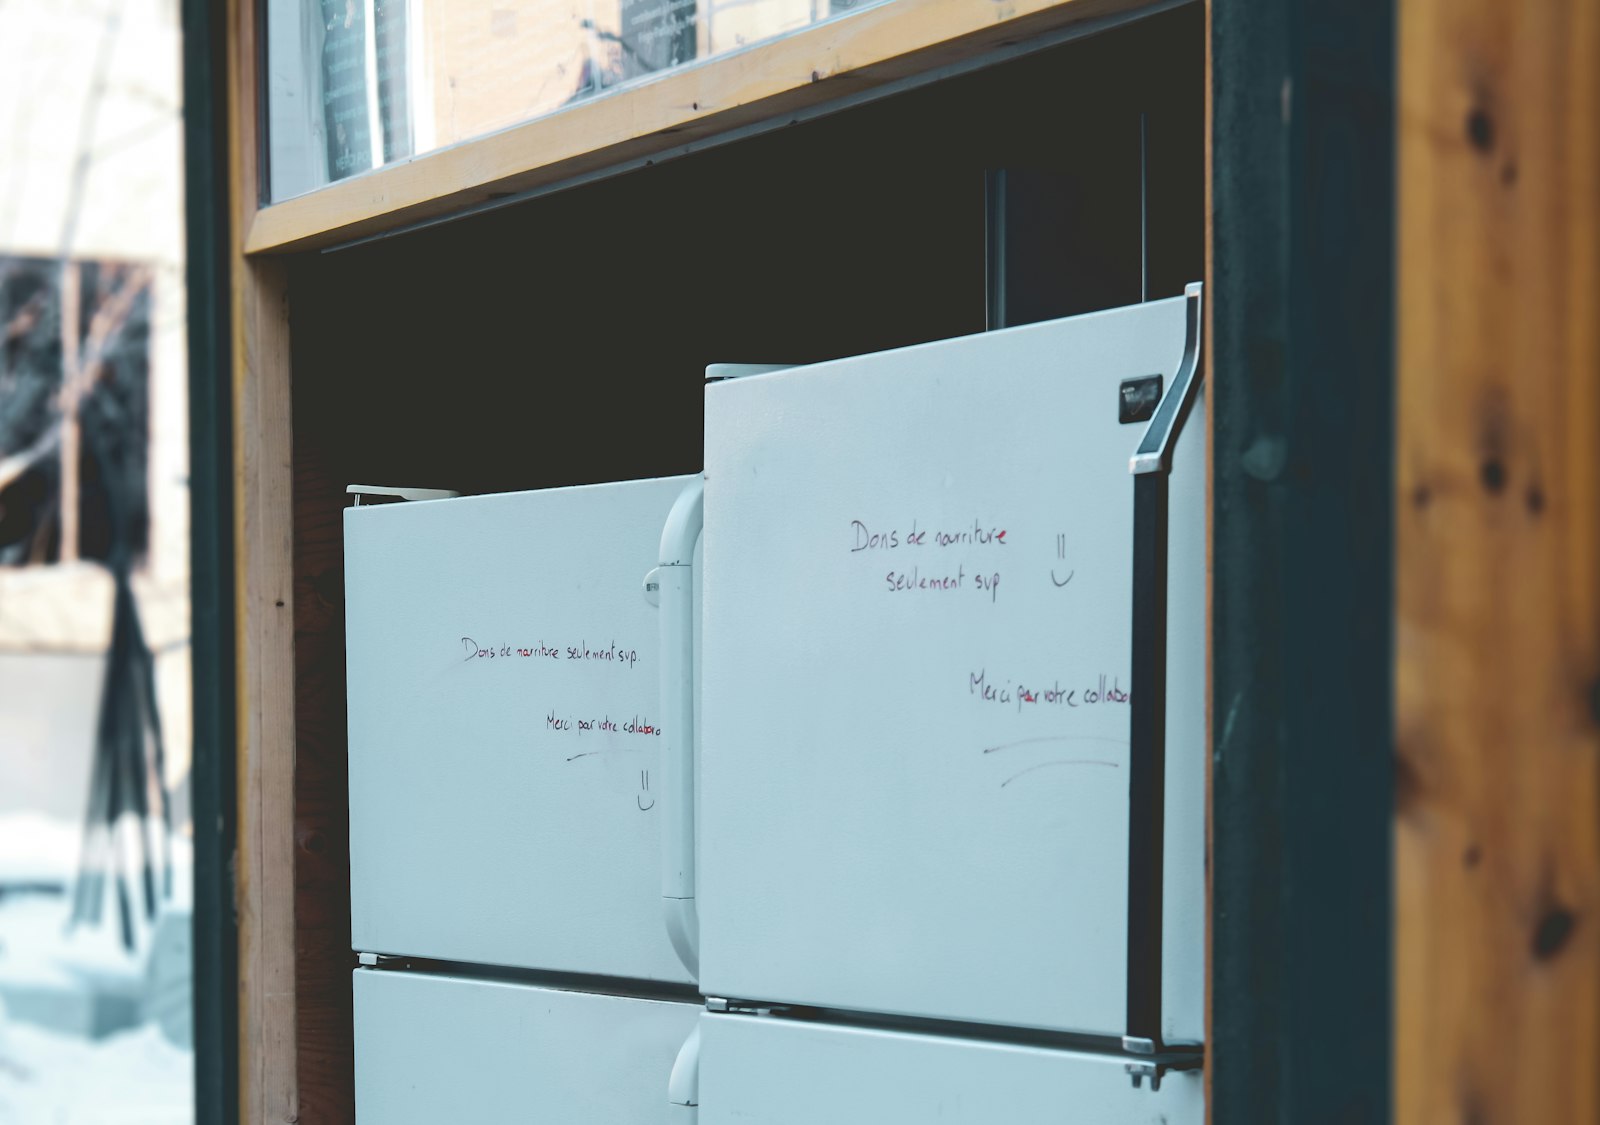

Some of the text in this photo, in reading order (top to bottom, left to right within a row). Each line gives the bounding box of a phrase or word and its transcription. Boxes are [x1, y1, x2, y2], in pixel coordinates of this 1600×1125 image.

[851, 519, 899, 552] Dons
[906, 518, 926, 546] de
[886, 564, 1001, 603] seulement svp
[461, 637, 496, 662] Dons
[499, 642, 512, 658] de
[566, 639, 616, 662] seulement
[969, 668, 1011, 704] Merci
[1044, 680, 1079, 707] votre
[546, 709, 573, 731] Merci
[597, 714, 618, 732] votre
